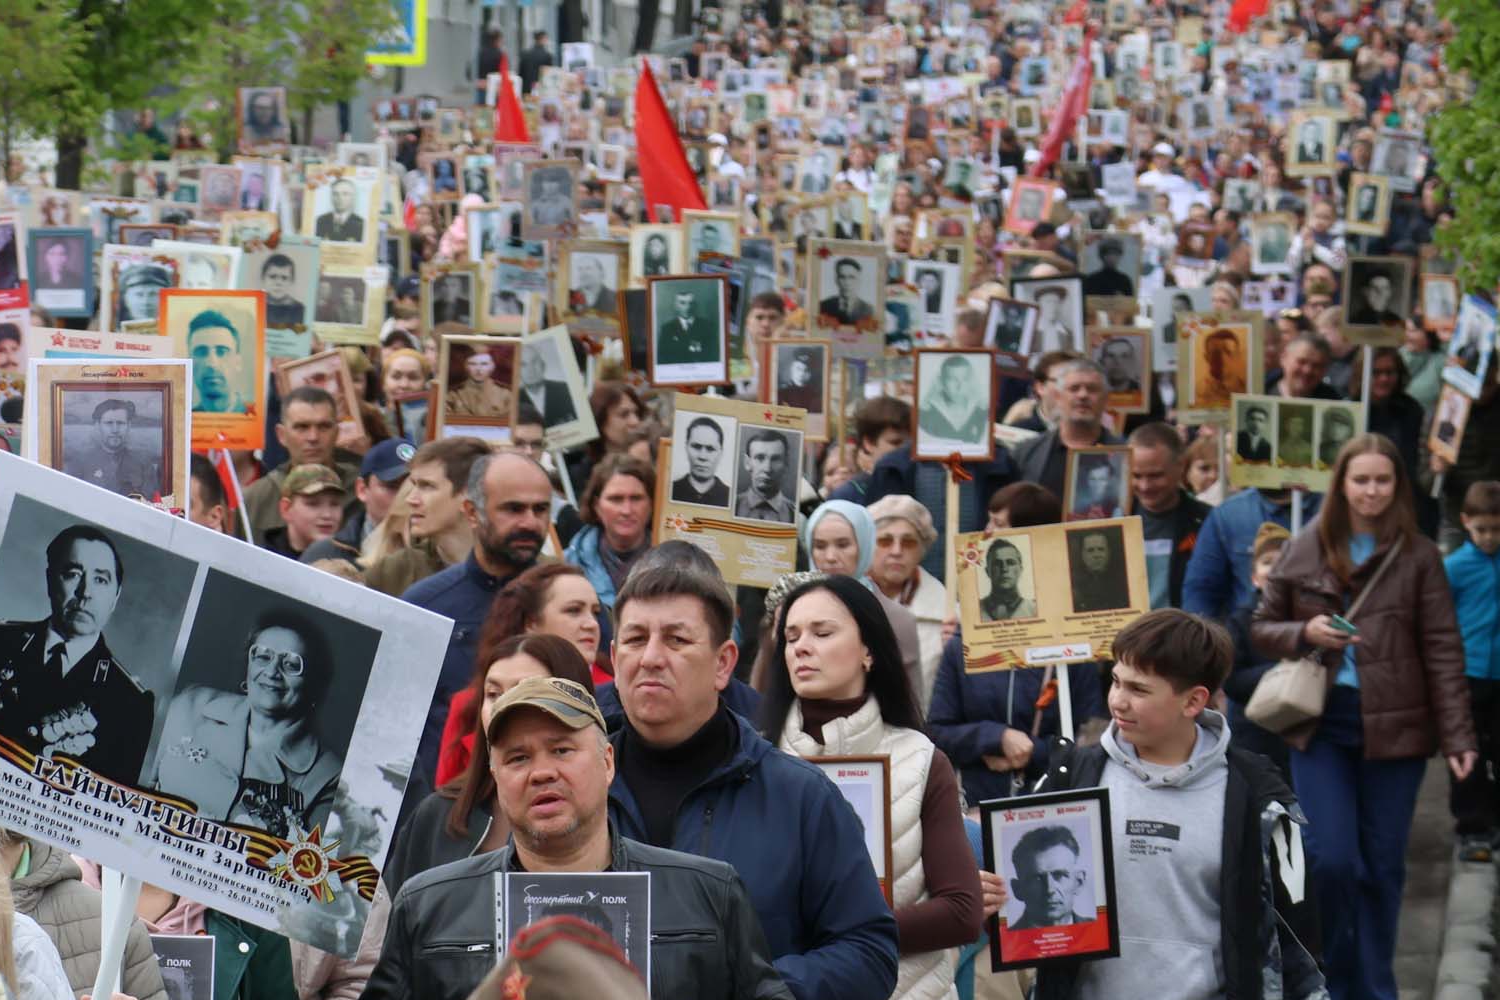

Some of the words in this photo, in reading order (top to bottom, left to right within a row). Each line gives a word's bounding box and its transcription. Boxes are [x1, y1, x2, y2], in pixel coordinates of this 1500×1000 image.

[32, 755, 251, 856] ГАЙНУЛЛИНЫ
[41, 785, 125, 827] Валеевич
[134, 819, 209, 860] Мавлия
[170, 867, 219, 893] 10.10.1923
[227, 888, 276, 914] 26.03.2016
